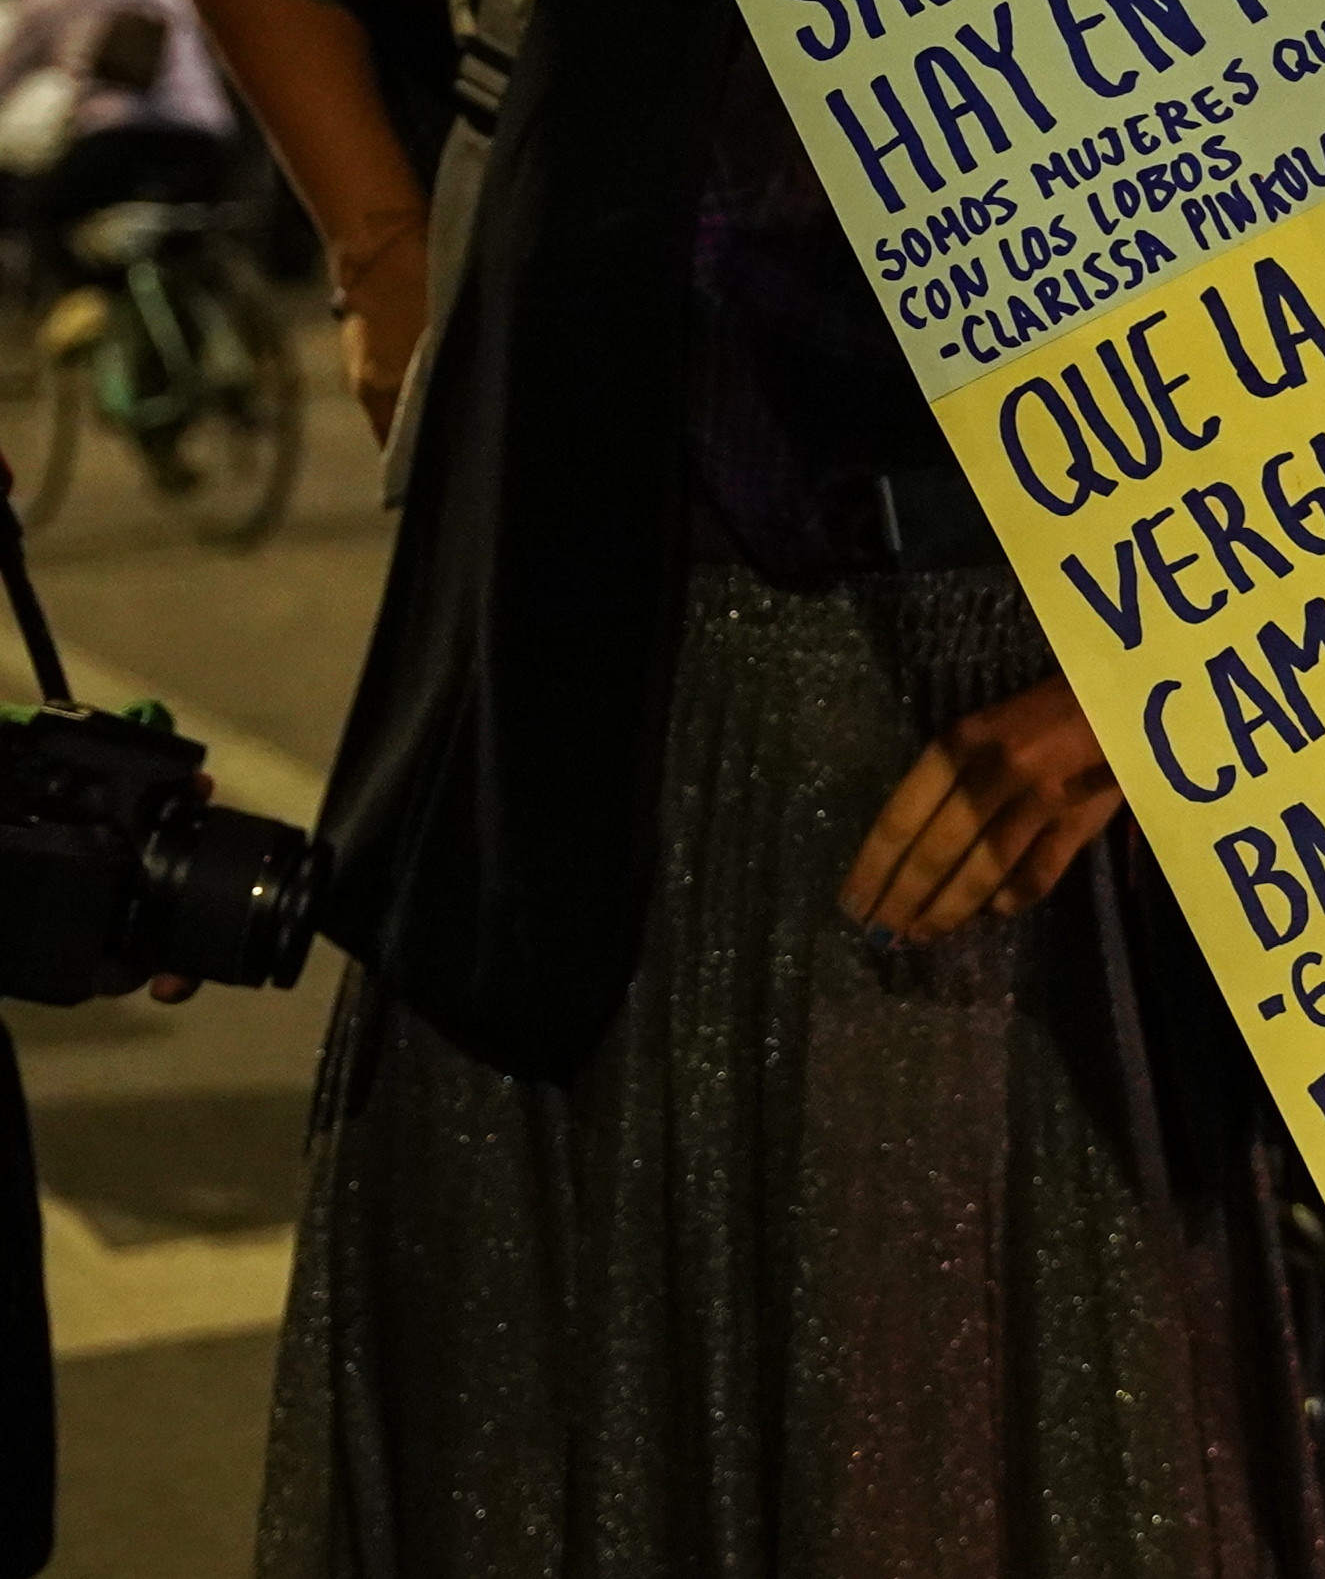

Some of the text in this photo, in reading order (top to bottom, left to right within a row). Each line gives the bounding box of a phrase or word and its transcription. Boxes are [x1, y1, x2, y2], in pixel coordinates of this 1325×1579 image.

[824, 1, 1057, 215] HAY
[875, 177, 1019, 280] SOMOS
[1028, 56, 1260, 200] MUJERES
[899, 133, 1243, 331] CON LOS LOBOS
[998, 312, 1221, 517] QUE
